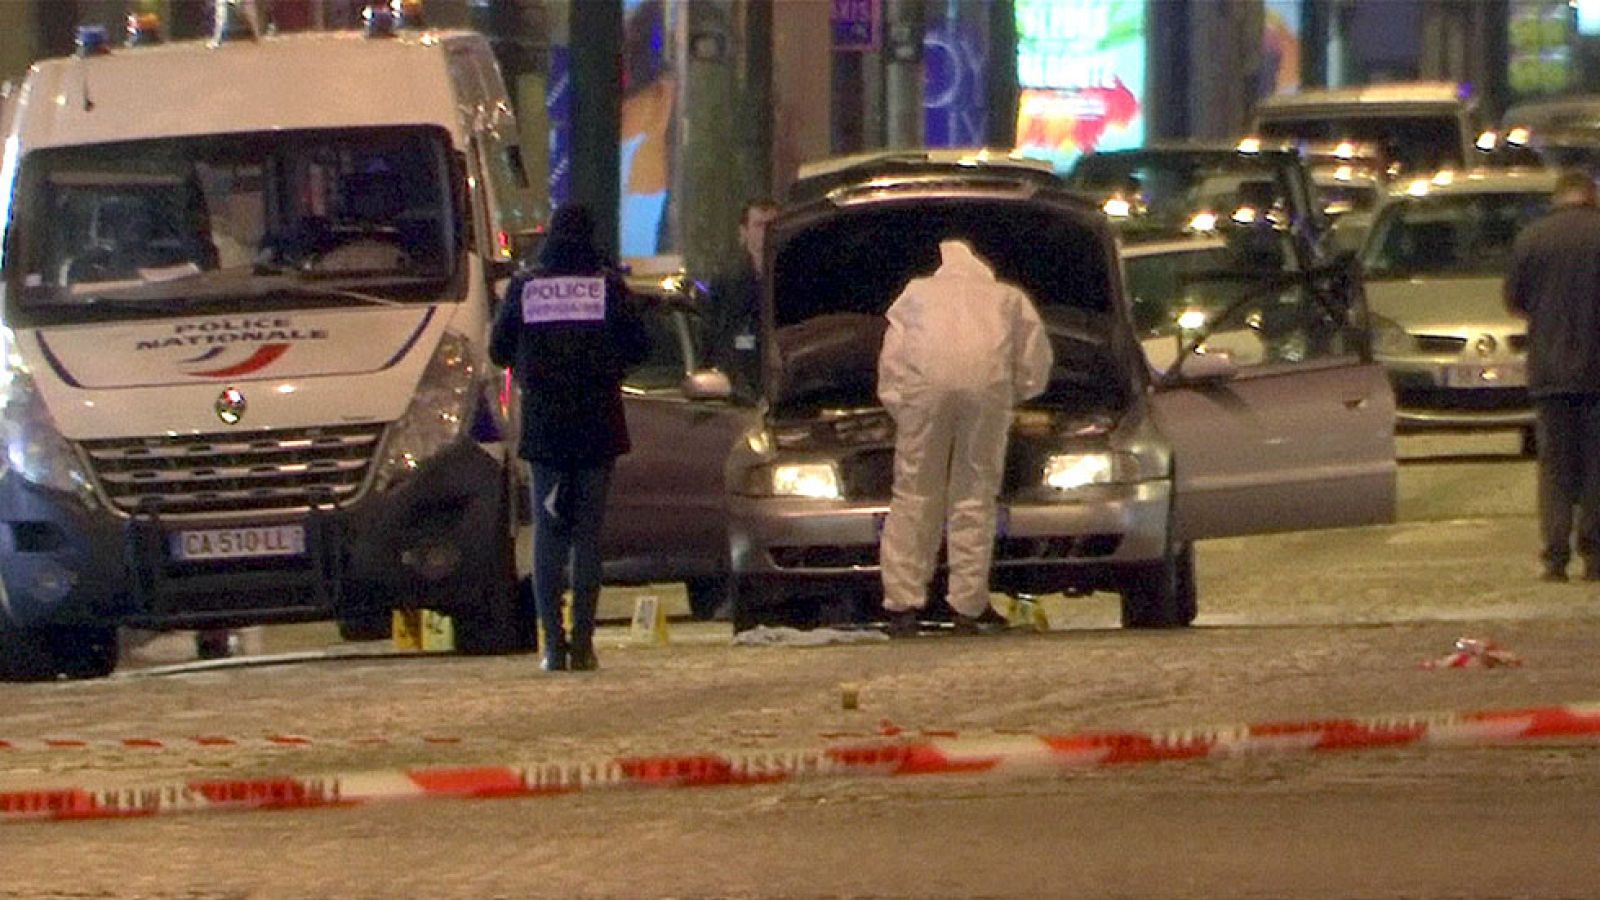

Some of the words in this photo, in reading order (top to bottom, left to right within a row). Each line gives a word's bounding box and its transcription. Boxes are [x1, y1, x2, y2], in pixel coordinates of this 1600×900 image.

[526, 283, 602, 299] POLICE
[175, 318, 289, 333] POLICE
[136, 329, 328, 350] NATIONALE
